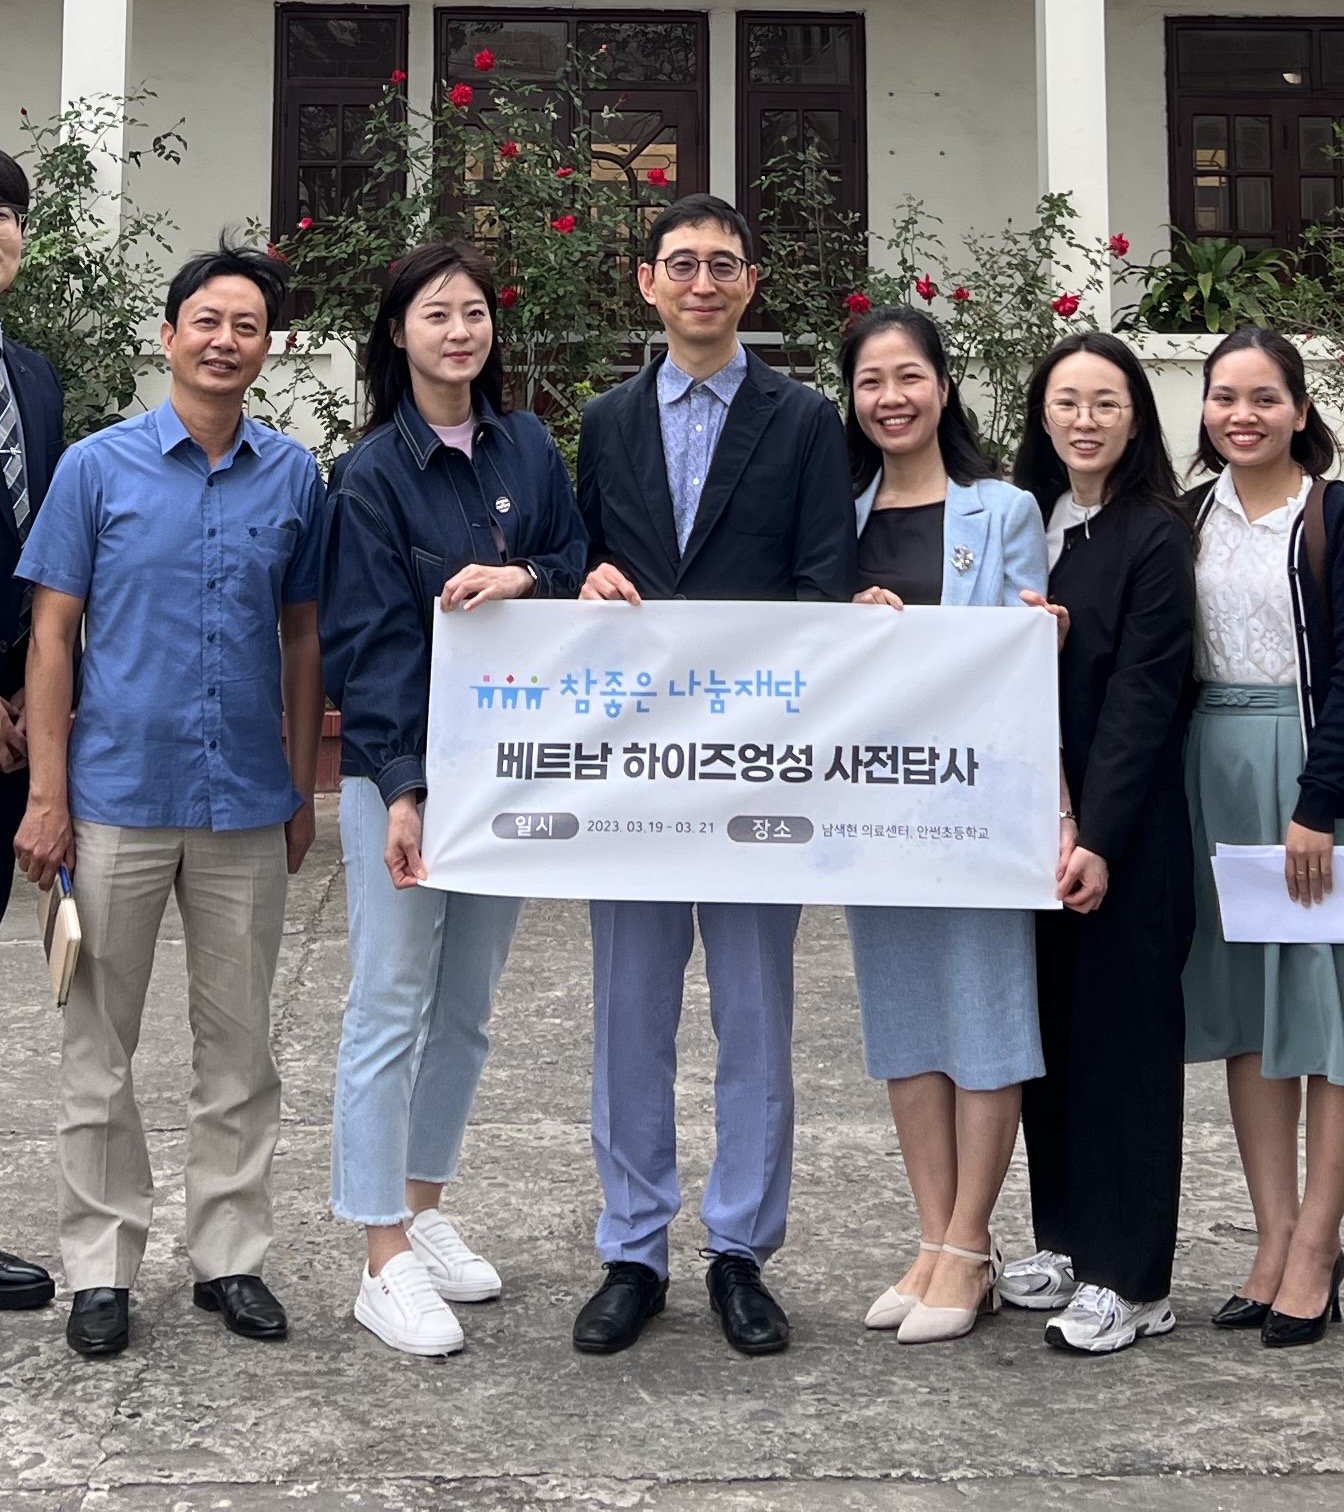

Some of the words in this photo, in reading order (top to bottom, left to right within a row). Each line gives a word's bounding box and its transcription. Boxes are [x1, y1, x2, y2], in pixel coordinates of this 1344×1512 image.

[560, 667, 657, 719] 참좋은
[668, 669, 807, 715] 나눔재단
[495, 741, 612, 780] 베트남
[622, 741, 814, 783] 하이즈엉성
[823, 744, 979, 786] 사전답사
[515, 815, 553, 837] 일시
[752, 819, 792, 841] 장소
[822, 823, 858, 838] 남색현
